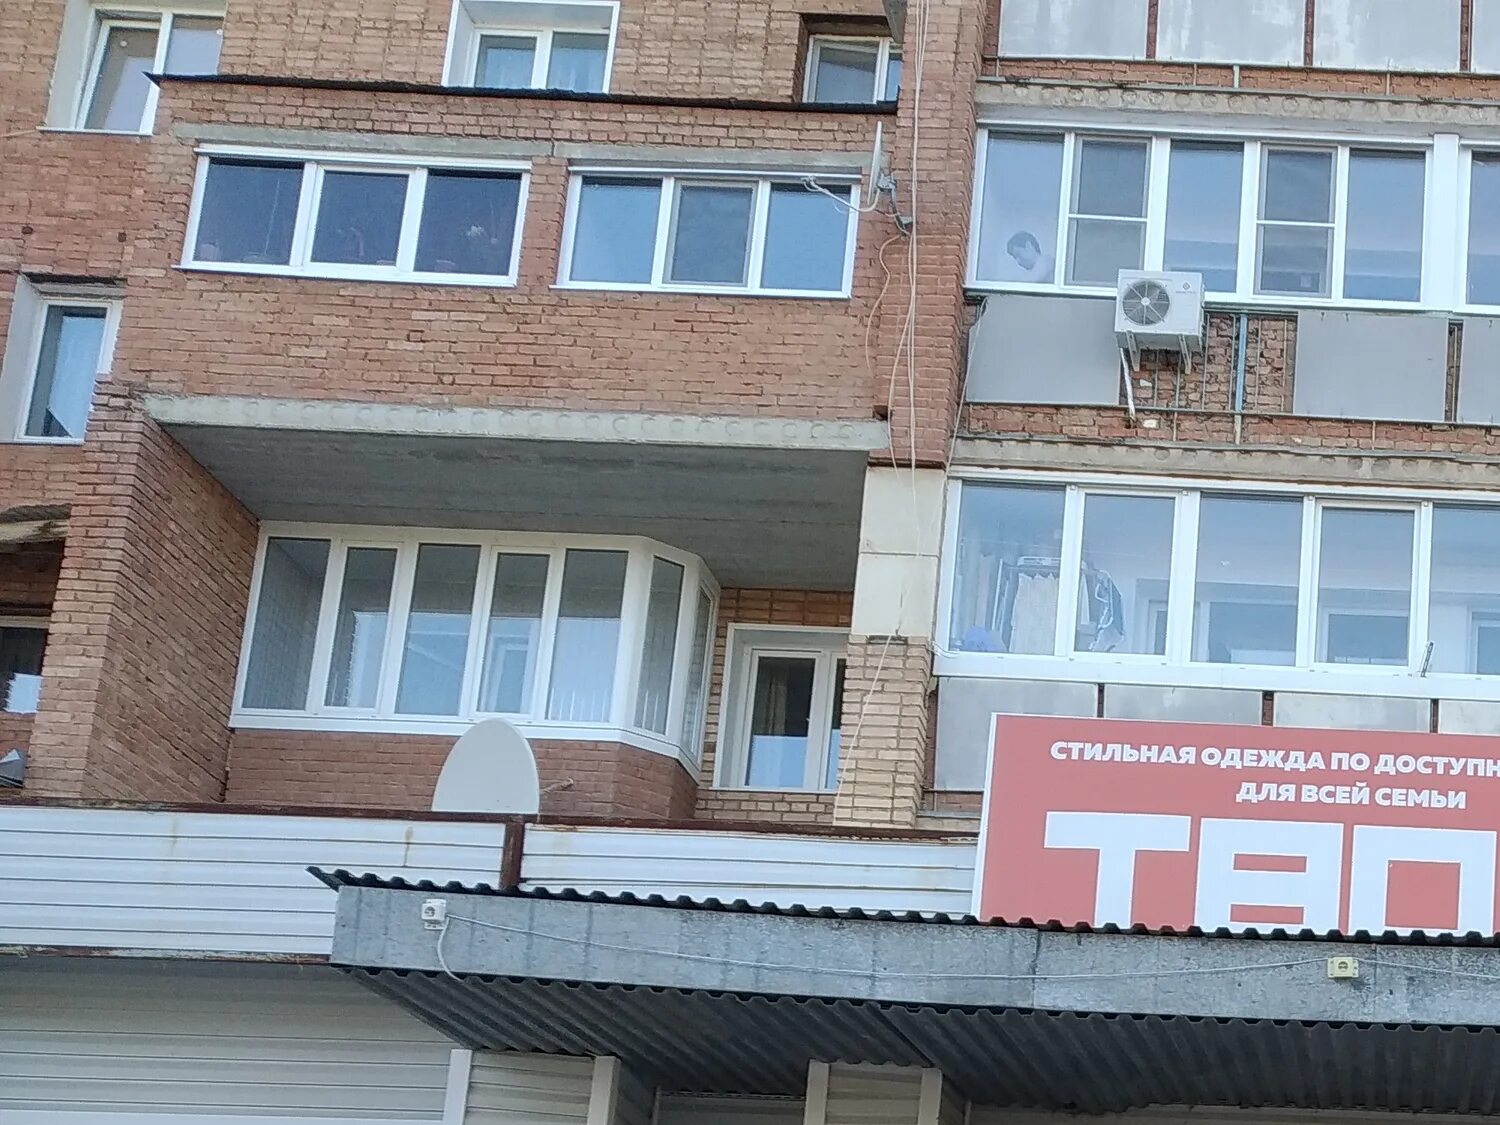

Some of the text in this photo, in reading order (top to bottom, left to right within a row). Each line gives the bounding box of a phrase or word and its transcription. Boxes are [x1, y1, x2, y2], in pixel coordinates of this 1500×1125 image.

[1050, 741, 1196, 765] СТИЛЬНАЯ
[1200, 747, 1326, 771] ОДЕЖДА
[1331, 751, 1370, 771] ПО
[1235, 781, 1466, 809] ДЛЯ ВСЕЙ СЕМЬИ
